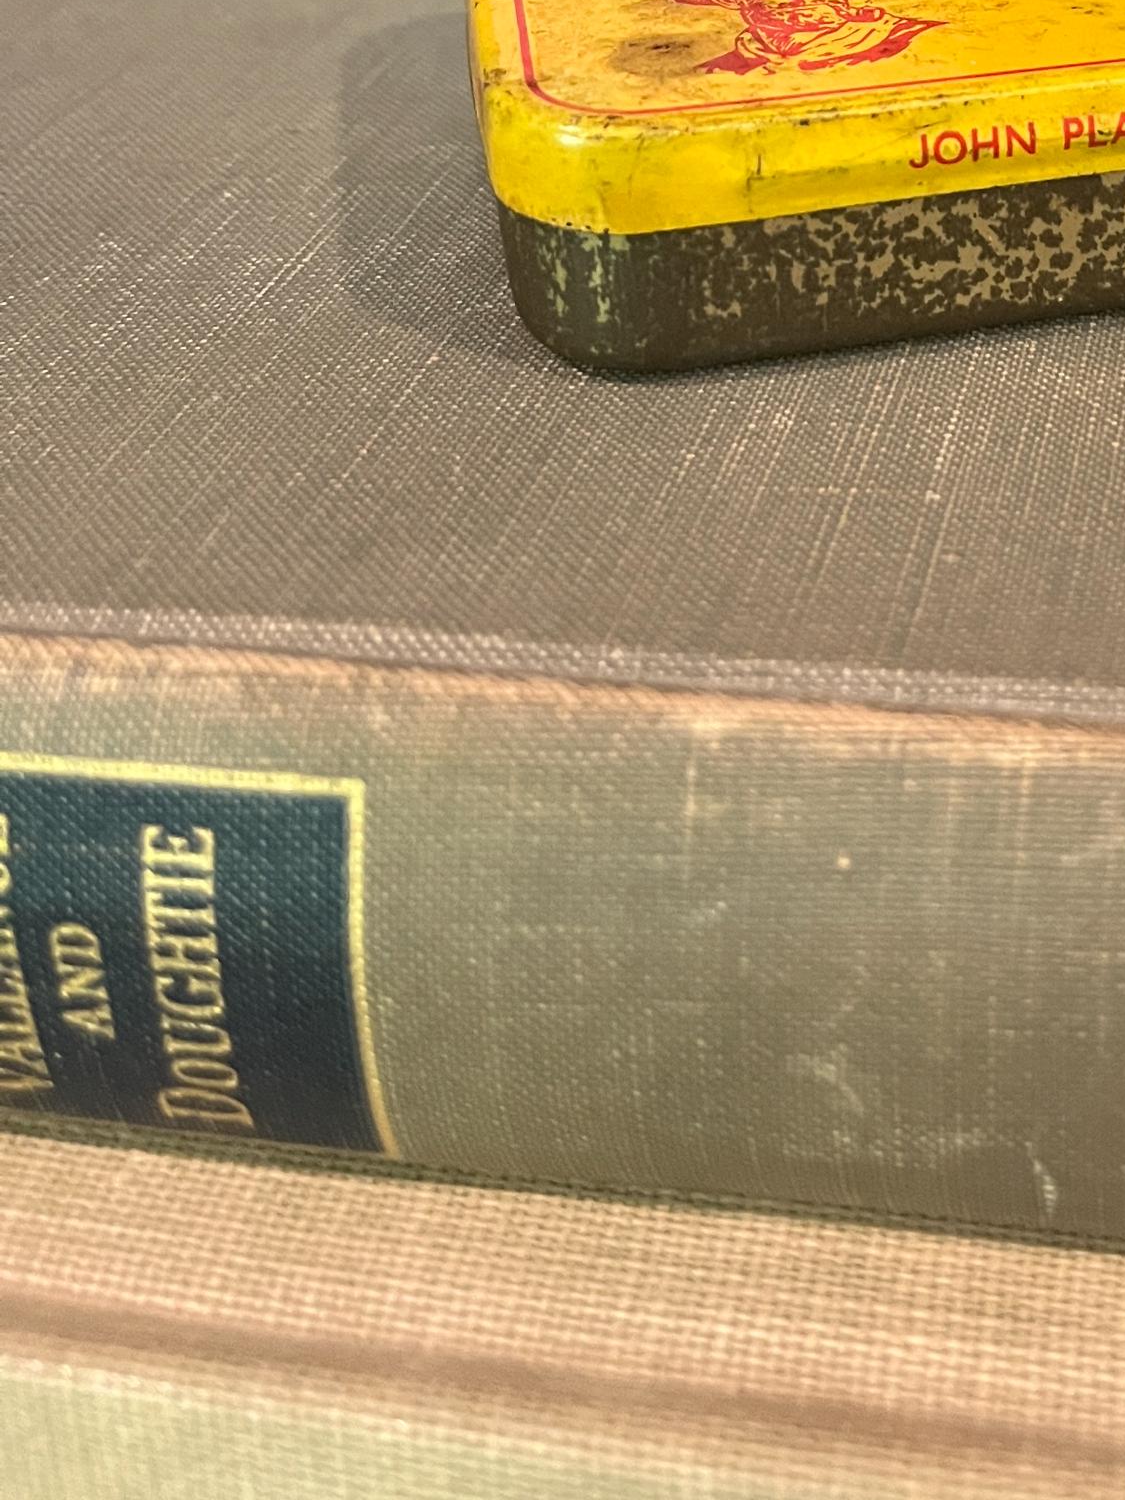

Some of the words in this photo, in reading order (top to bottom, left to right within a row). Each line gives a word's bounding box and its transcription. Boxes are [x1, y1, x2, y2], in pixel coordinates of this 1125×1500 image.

[908, 121, 1037, 170] JOHN
[49, 922, 116, 1040] AND
[140, 823, 255, 1129] DOUGHTIE
